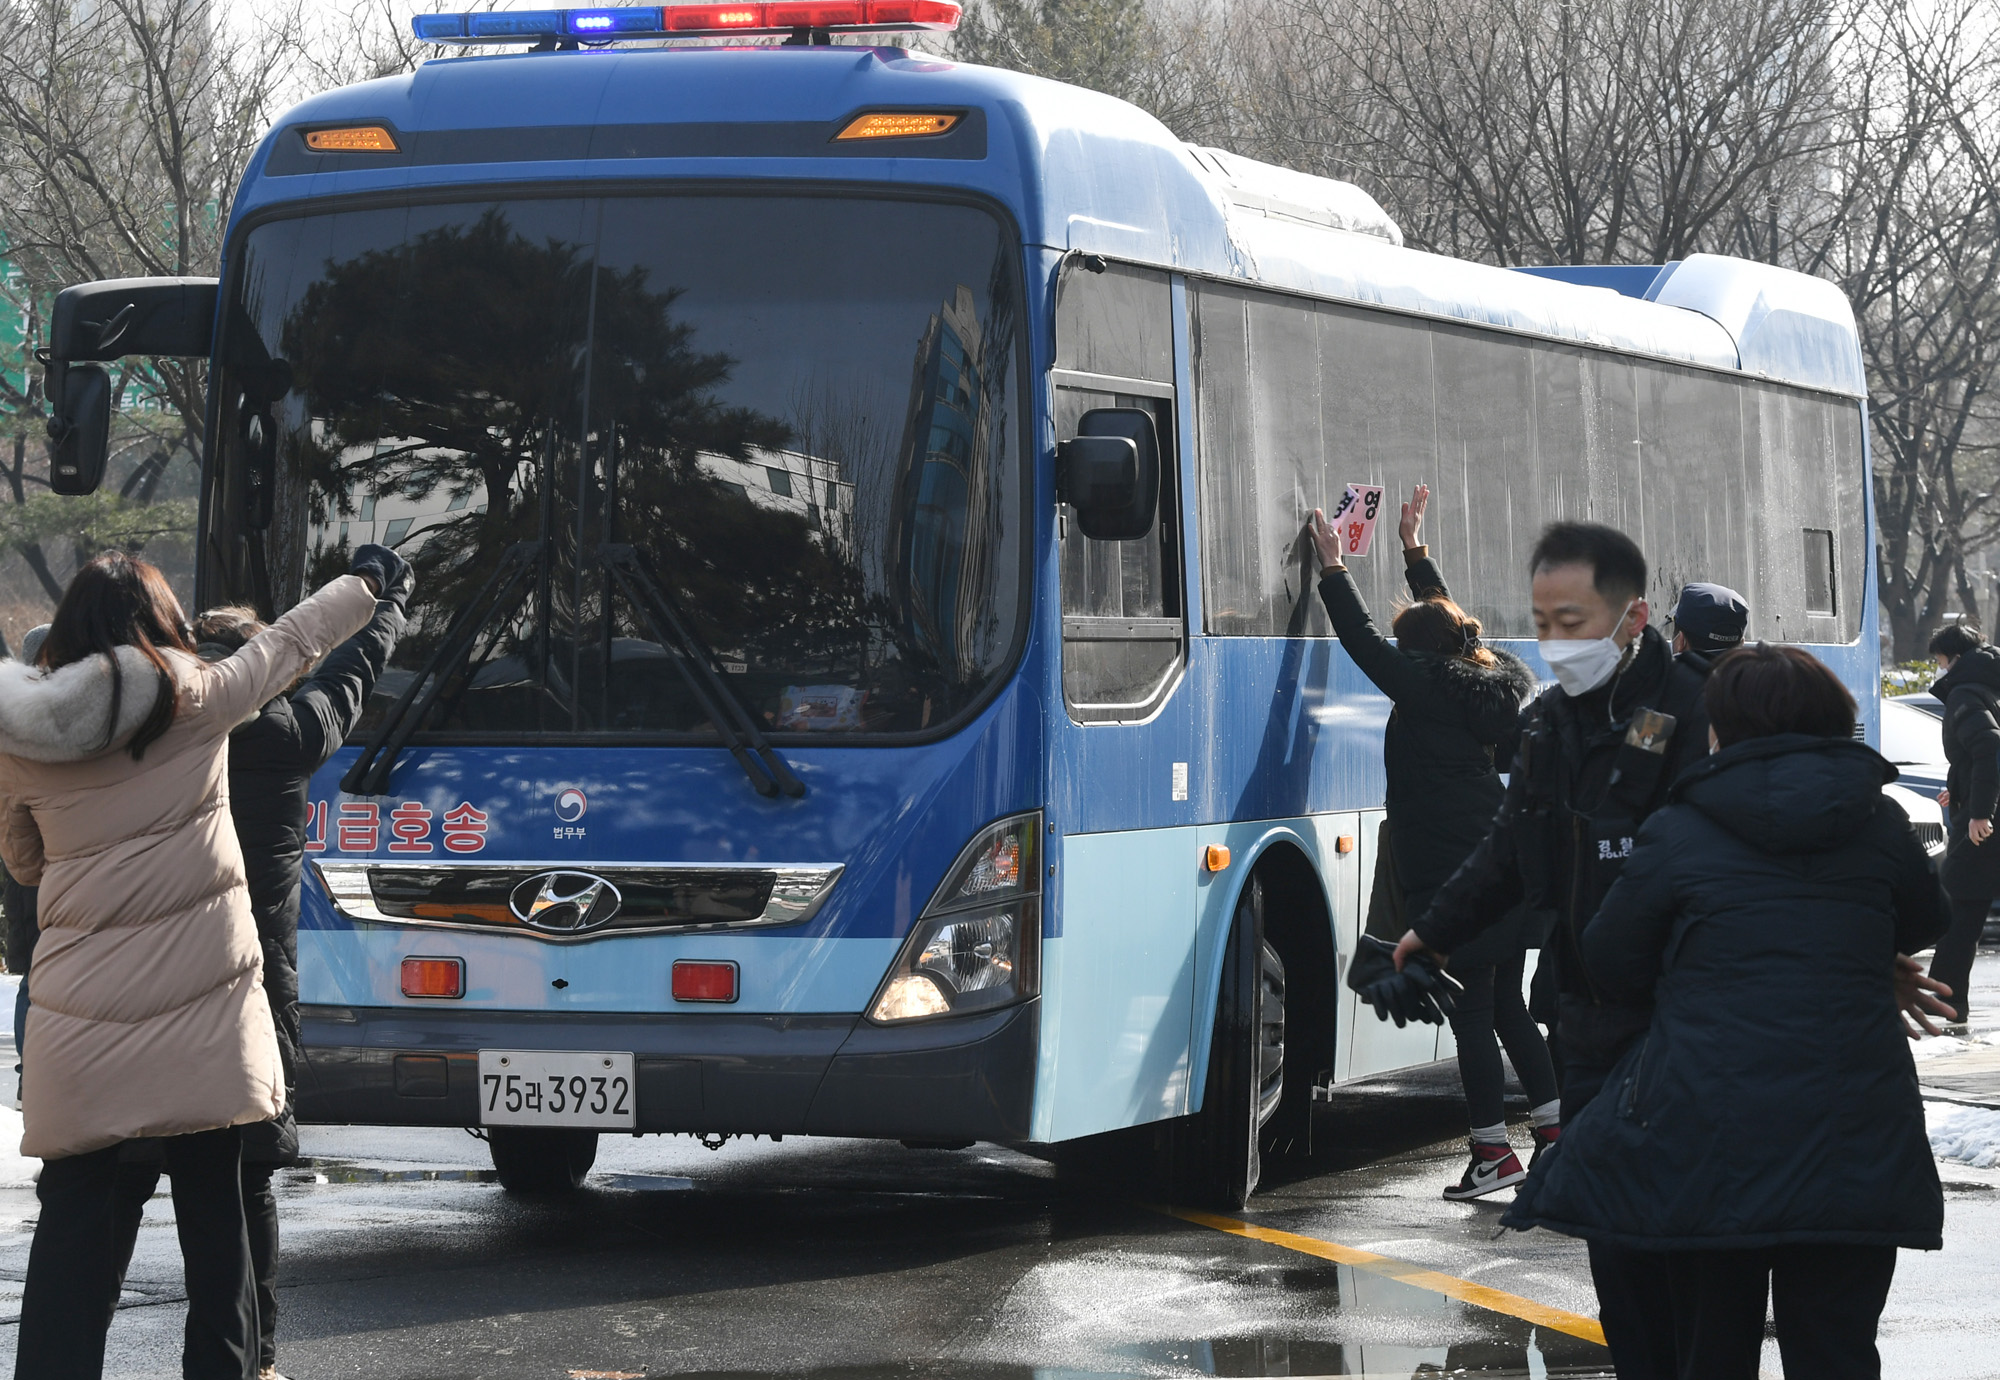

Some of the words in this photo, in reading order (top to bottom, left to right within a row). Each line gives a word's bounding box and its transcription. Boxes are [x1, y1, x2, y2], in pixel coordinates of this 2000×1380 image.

[553, 826, 587, 840] 법무부
[1599, 849, 1632, 861] POLIC
[483, 1074, 630, 1115] 75라3932
